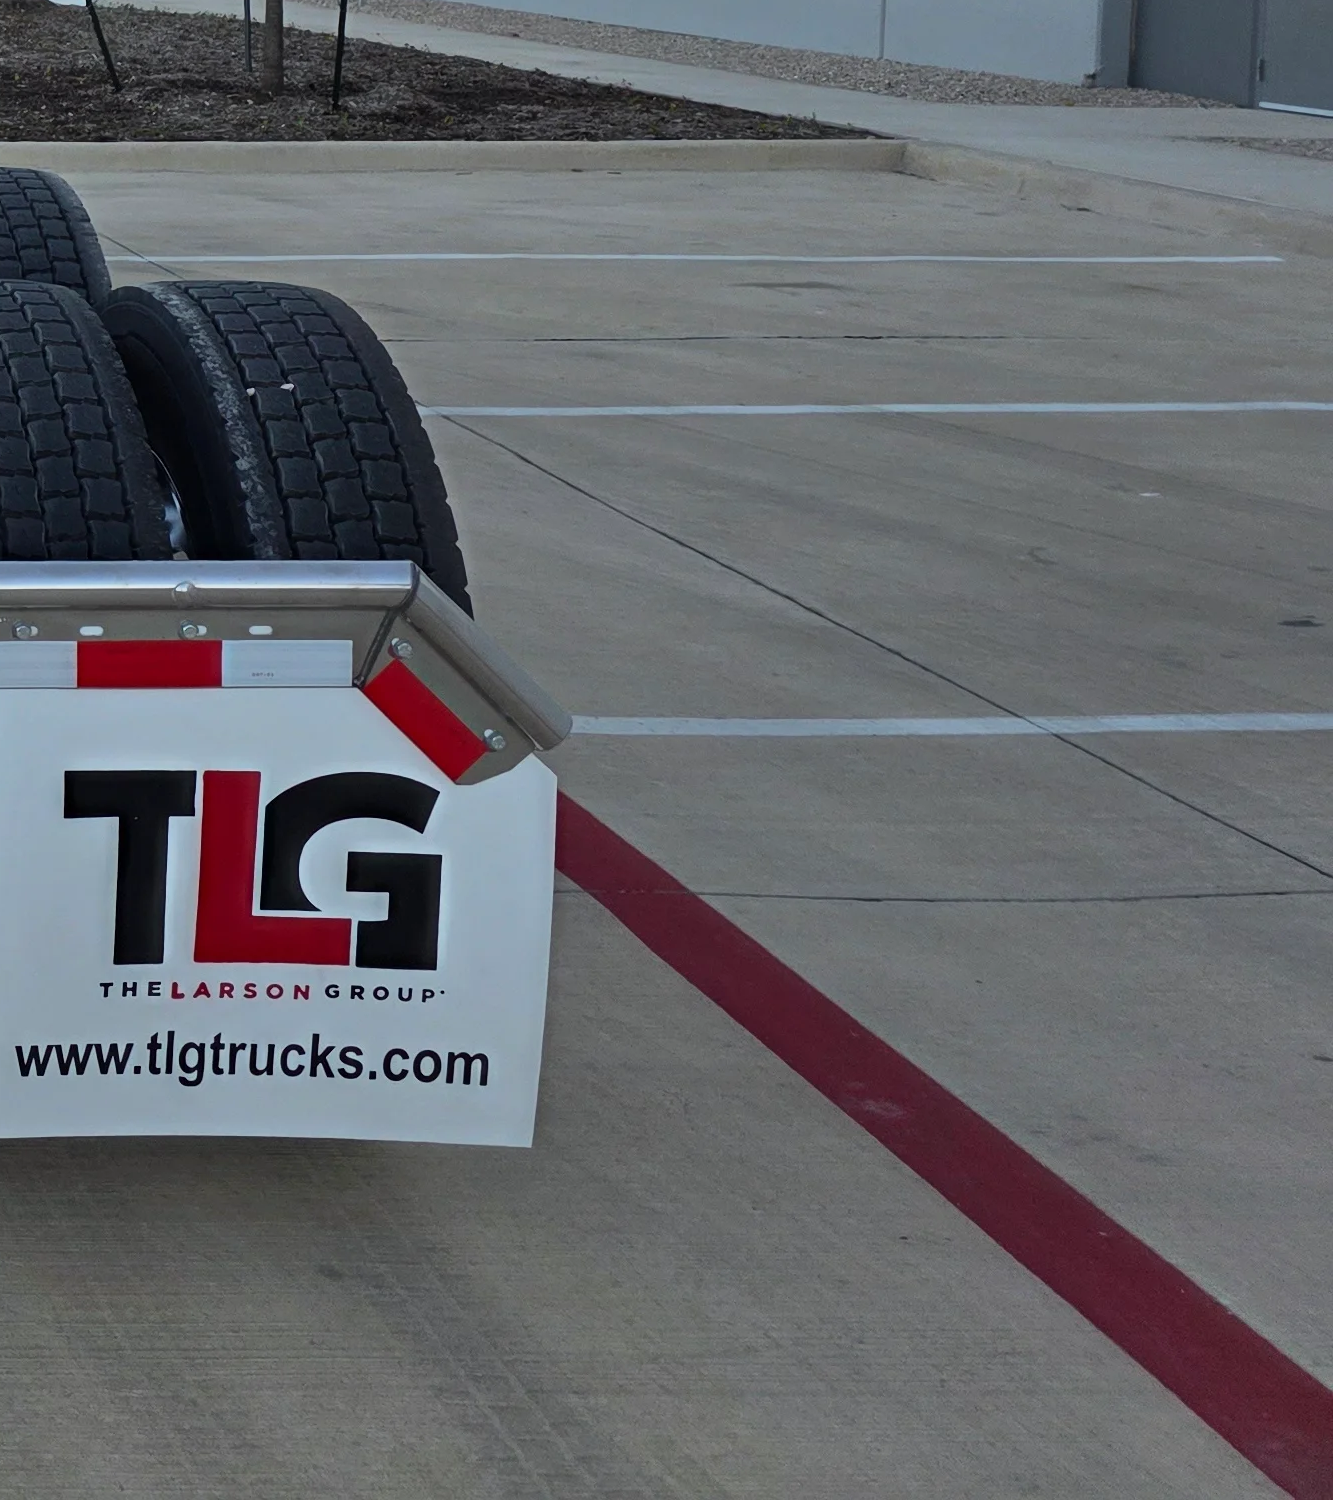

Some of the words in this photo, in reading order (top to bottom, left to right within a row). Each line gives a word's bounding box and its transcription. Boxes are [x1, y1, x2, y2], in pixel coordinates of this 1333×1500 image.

[63, 769, 443, 971] TLG
[324, 983, 436, 1003] GROUP
[14, 1030, 489, 1087] www.tlgtrucks.com
